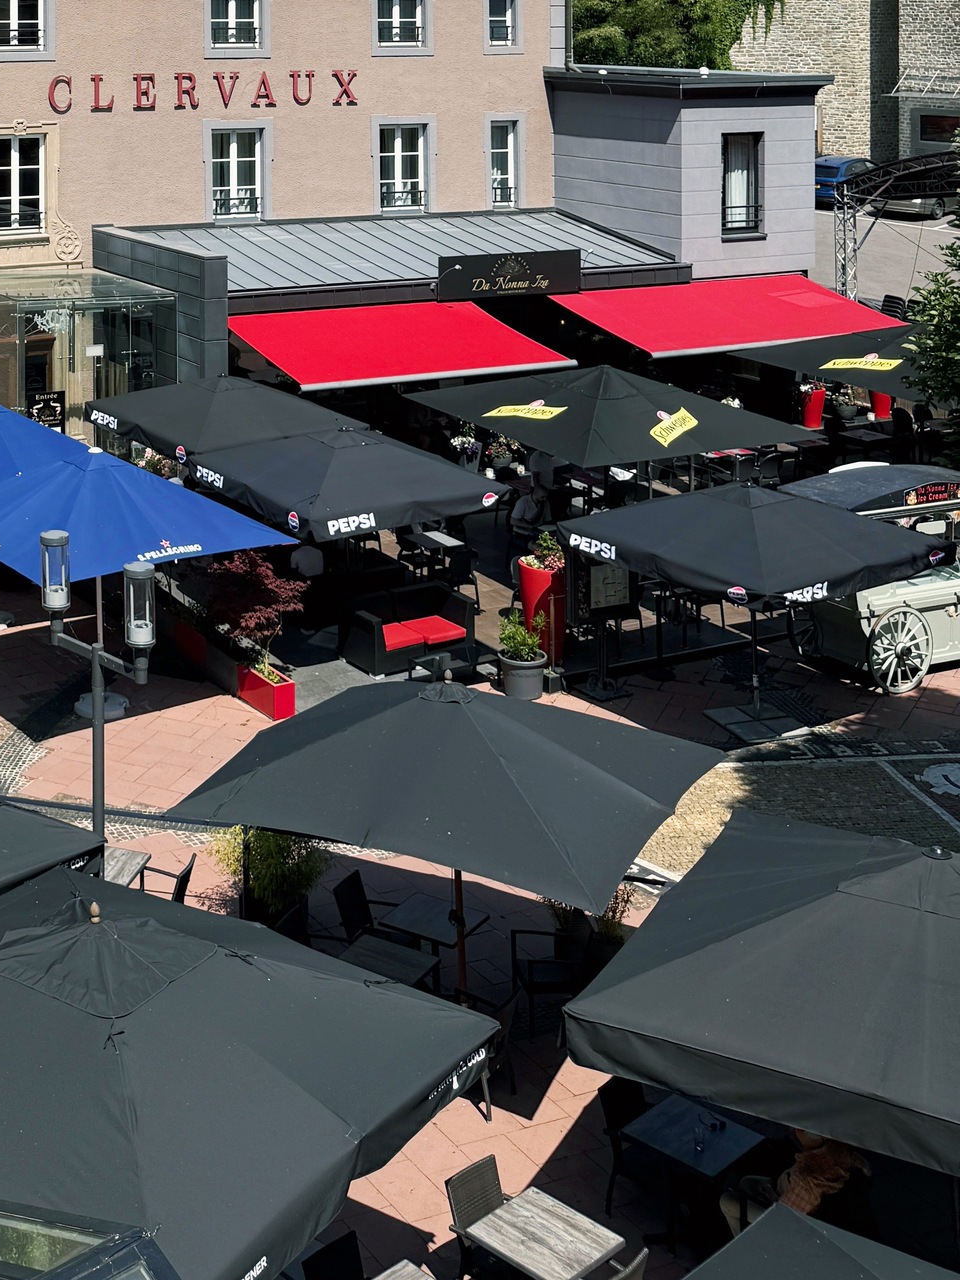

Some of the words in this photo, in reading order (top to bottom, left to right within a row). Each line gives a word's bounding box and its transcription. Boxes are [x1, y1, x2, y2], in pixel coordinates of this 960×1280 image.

[48, 70, 359, 114] CLERVAUX
[471, 278, 491, 292] Da
[492, 275, 530, 291] Nonna
[35, 393, 58, 401] Entrée
[90, 409, 118, 430] PEPSI
[653, 414, 693, 443] Schweppes
[196, 465, 224, 489] PEPSI
[928, 492, 948, 500] Cream
[326, 512, 377, 536] PEPSI
[569, 533, 617, 560] PEPSI
[466, 1047, 486, 1067] COLD
